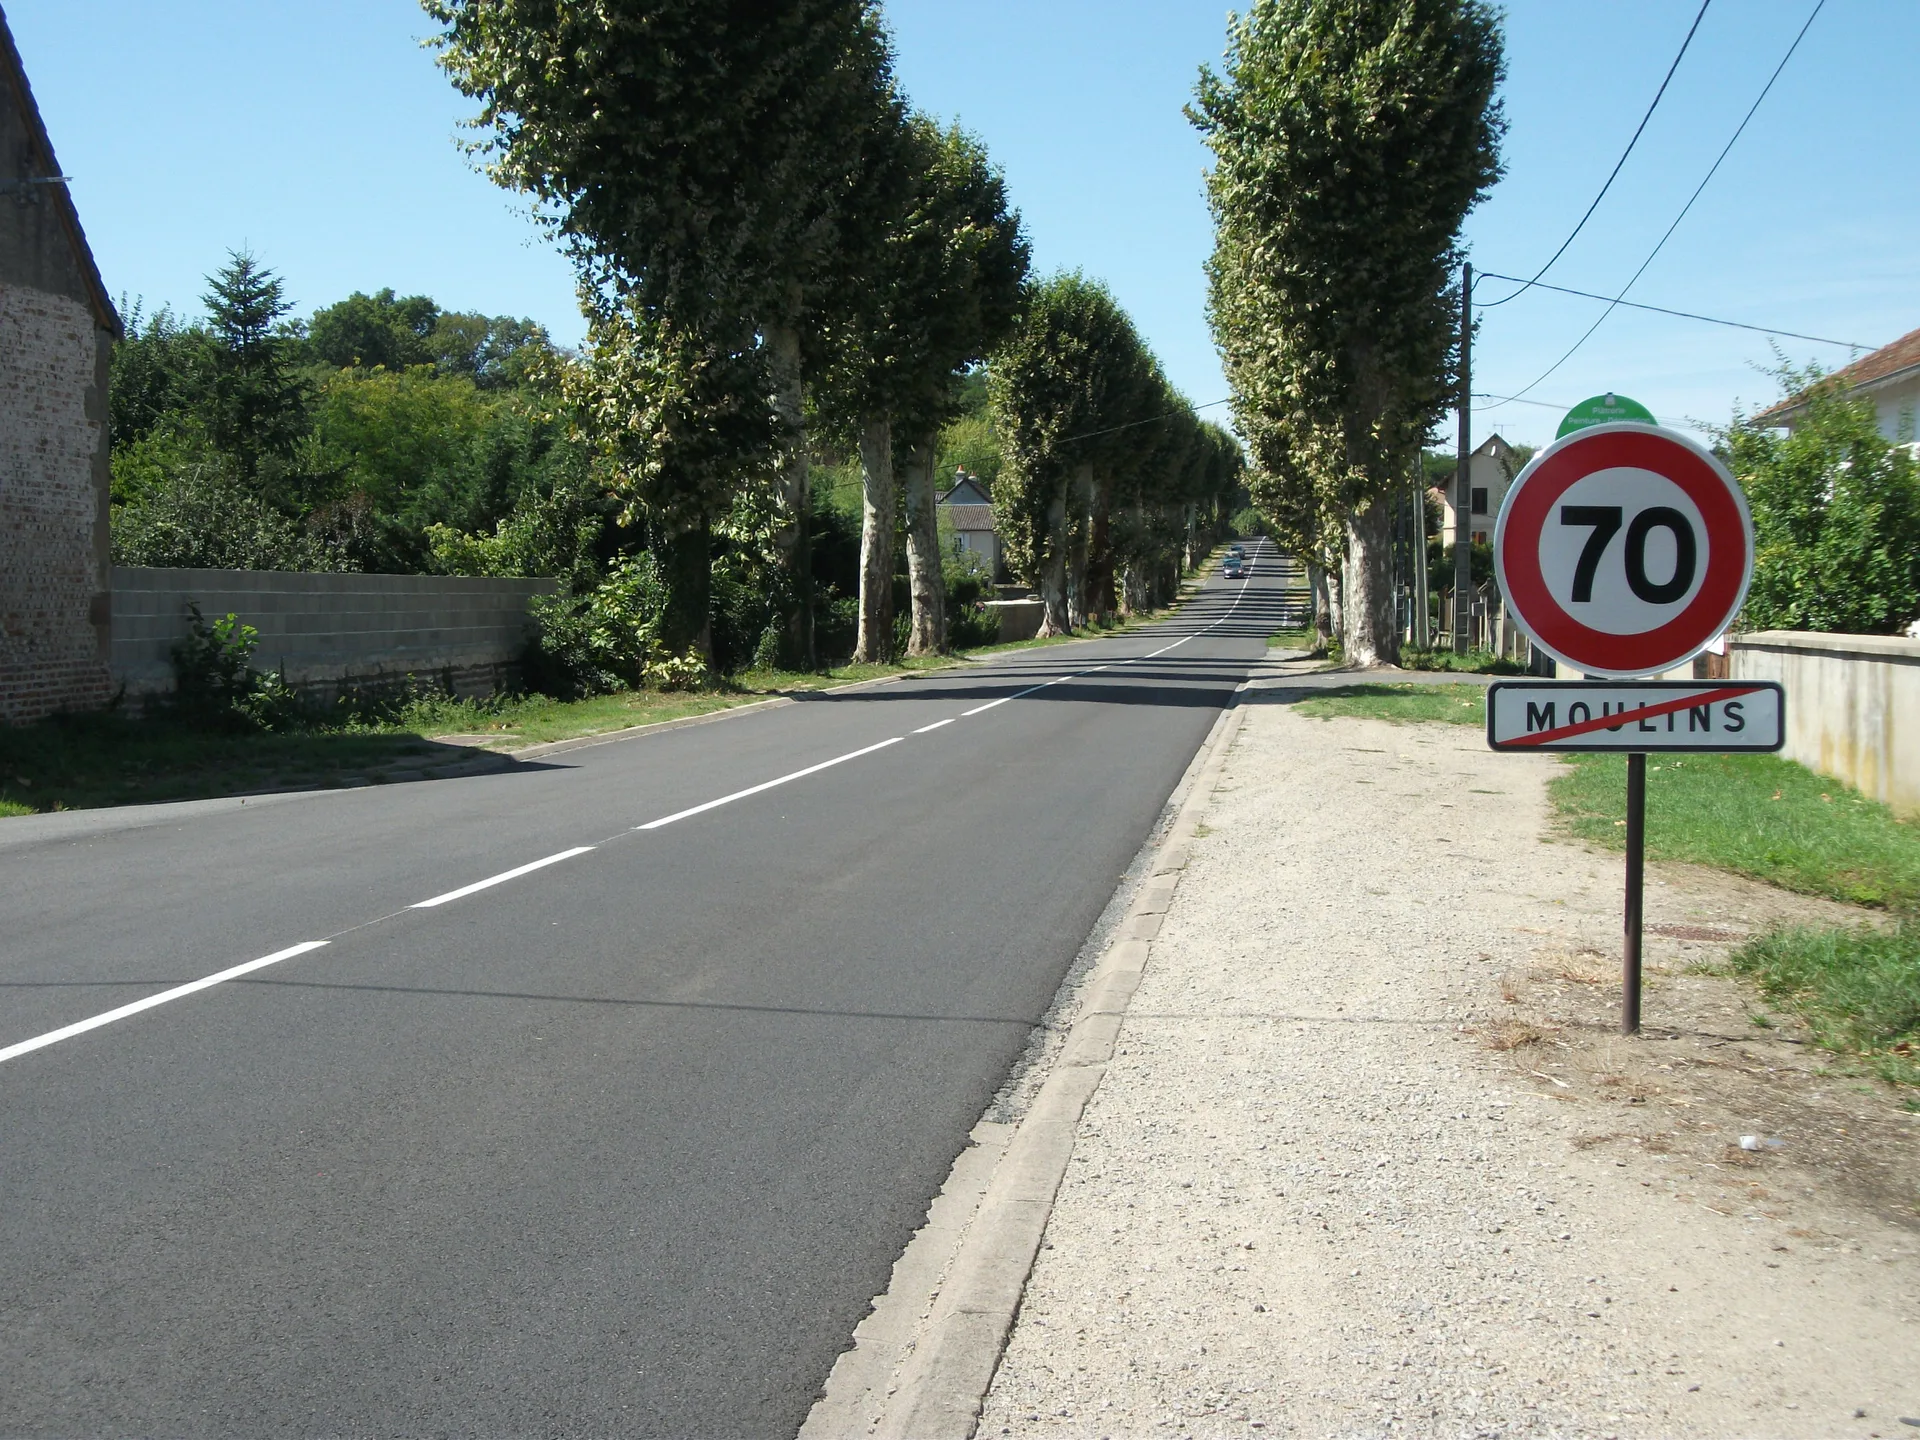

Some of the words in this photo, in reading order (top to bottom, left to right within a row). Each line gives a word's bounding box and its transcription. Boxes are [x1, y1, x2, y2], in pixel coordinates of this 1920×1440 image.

[1568, 417, 1601, 425] Peinture
[1560, 505, 1697, 604] 70
[1526, 701, 1746, 733] MOULINS
